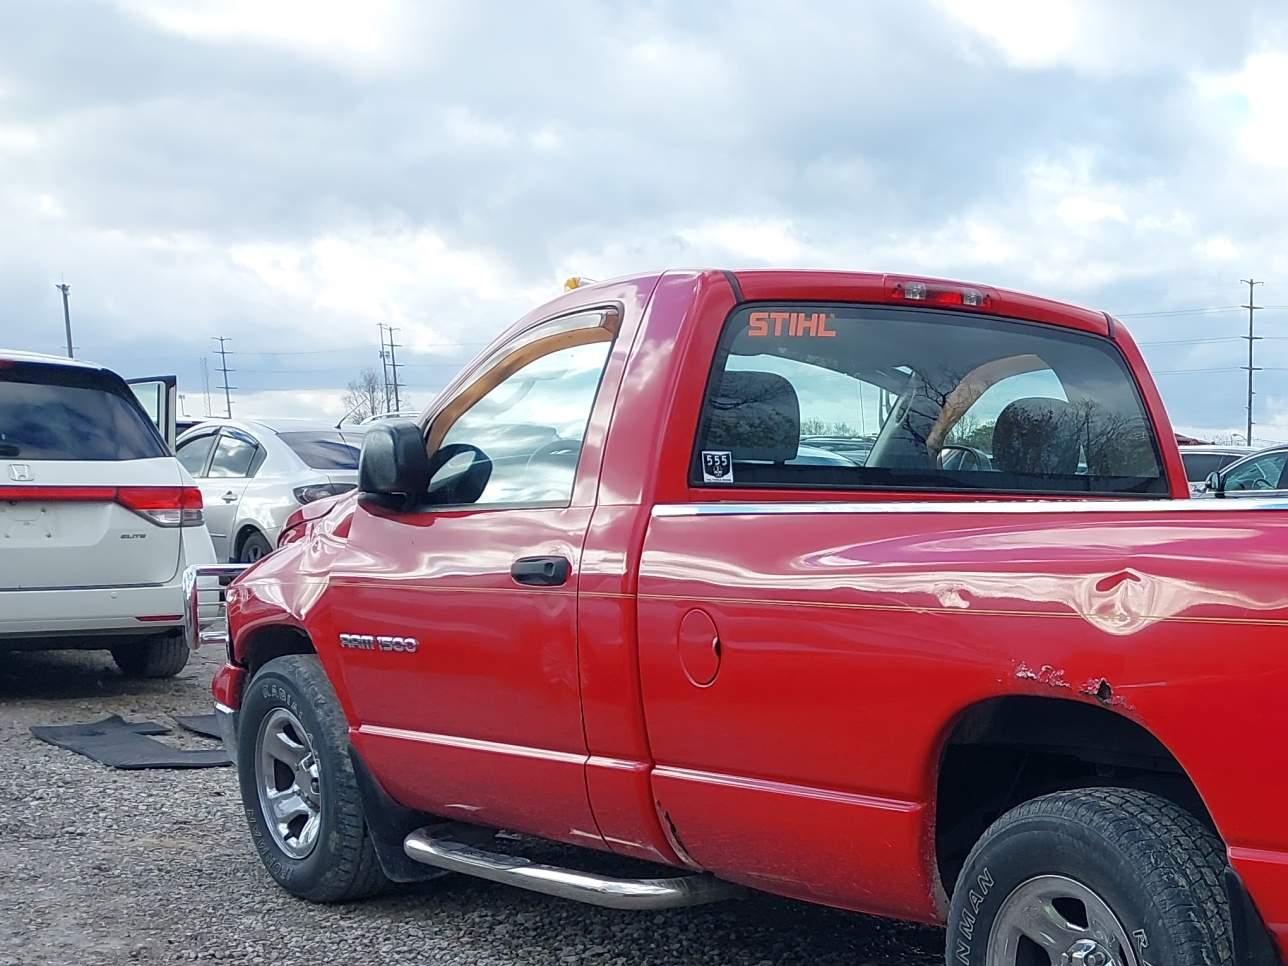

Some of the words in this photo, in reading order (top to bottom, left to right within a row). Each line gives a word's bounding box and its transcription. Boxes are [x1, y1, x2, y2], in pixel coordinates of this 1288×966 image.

[748, 312, 836, 337] STIHL
[339, 633, 375, 650] RAM
[377, 636, 417, 653] 1500
